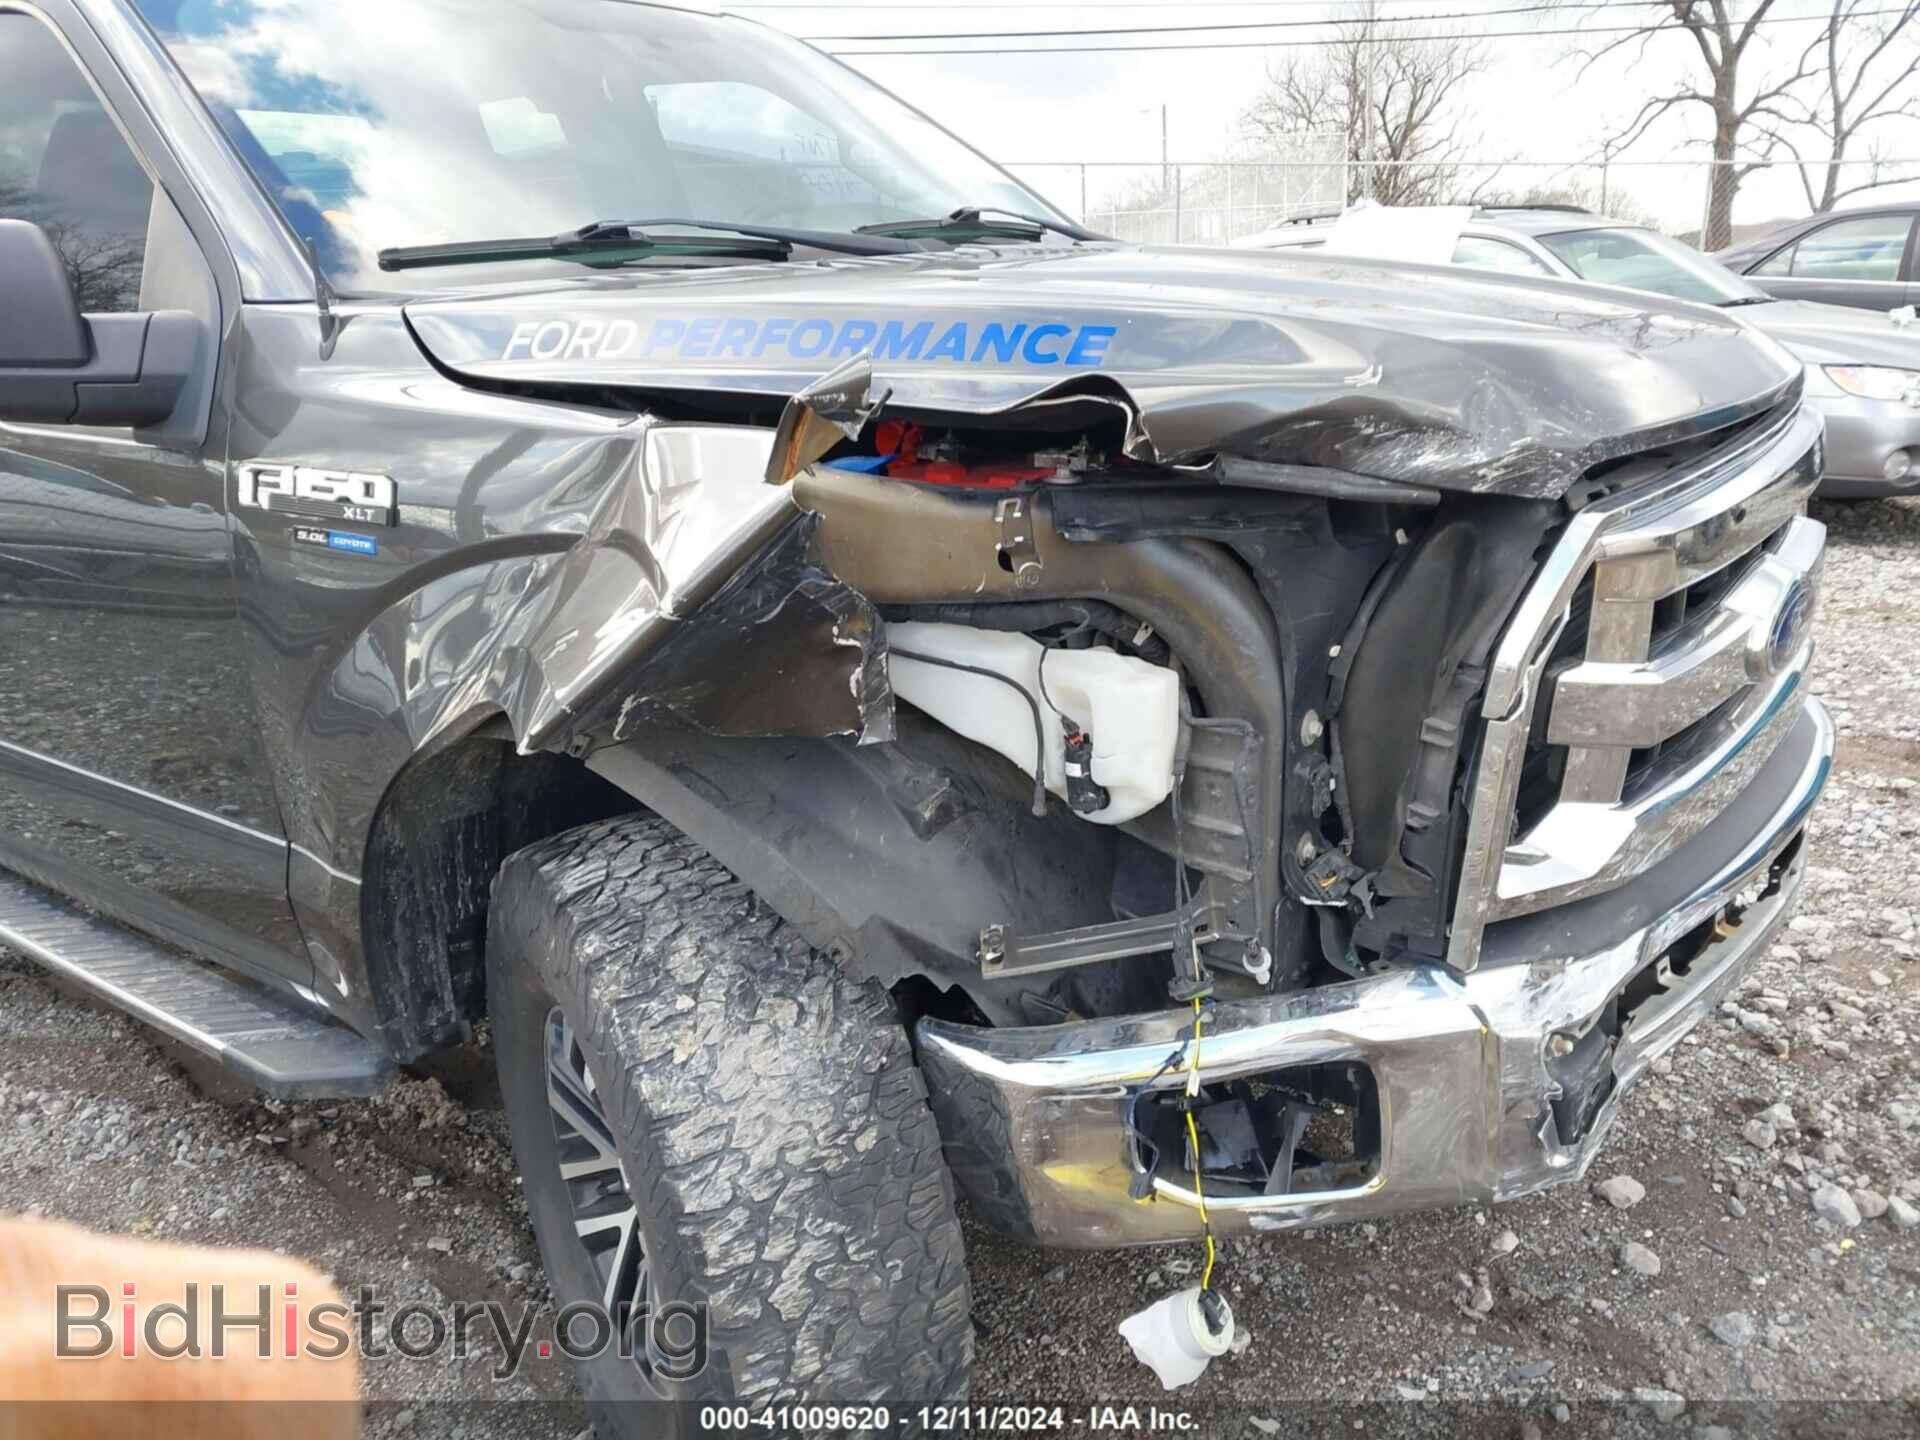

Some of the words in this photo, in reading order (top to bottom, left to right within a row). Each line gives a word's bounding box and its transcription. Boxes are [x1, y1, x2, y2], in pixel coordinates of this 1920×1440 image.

[503, 320, 637, 360] FORD
[644, 320, 1116, 364] PERFORMANCE
[343, 505, 375, 520] XLT
[297, 530, 328, 544] 5.0L
